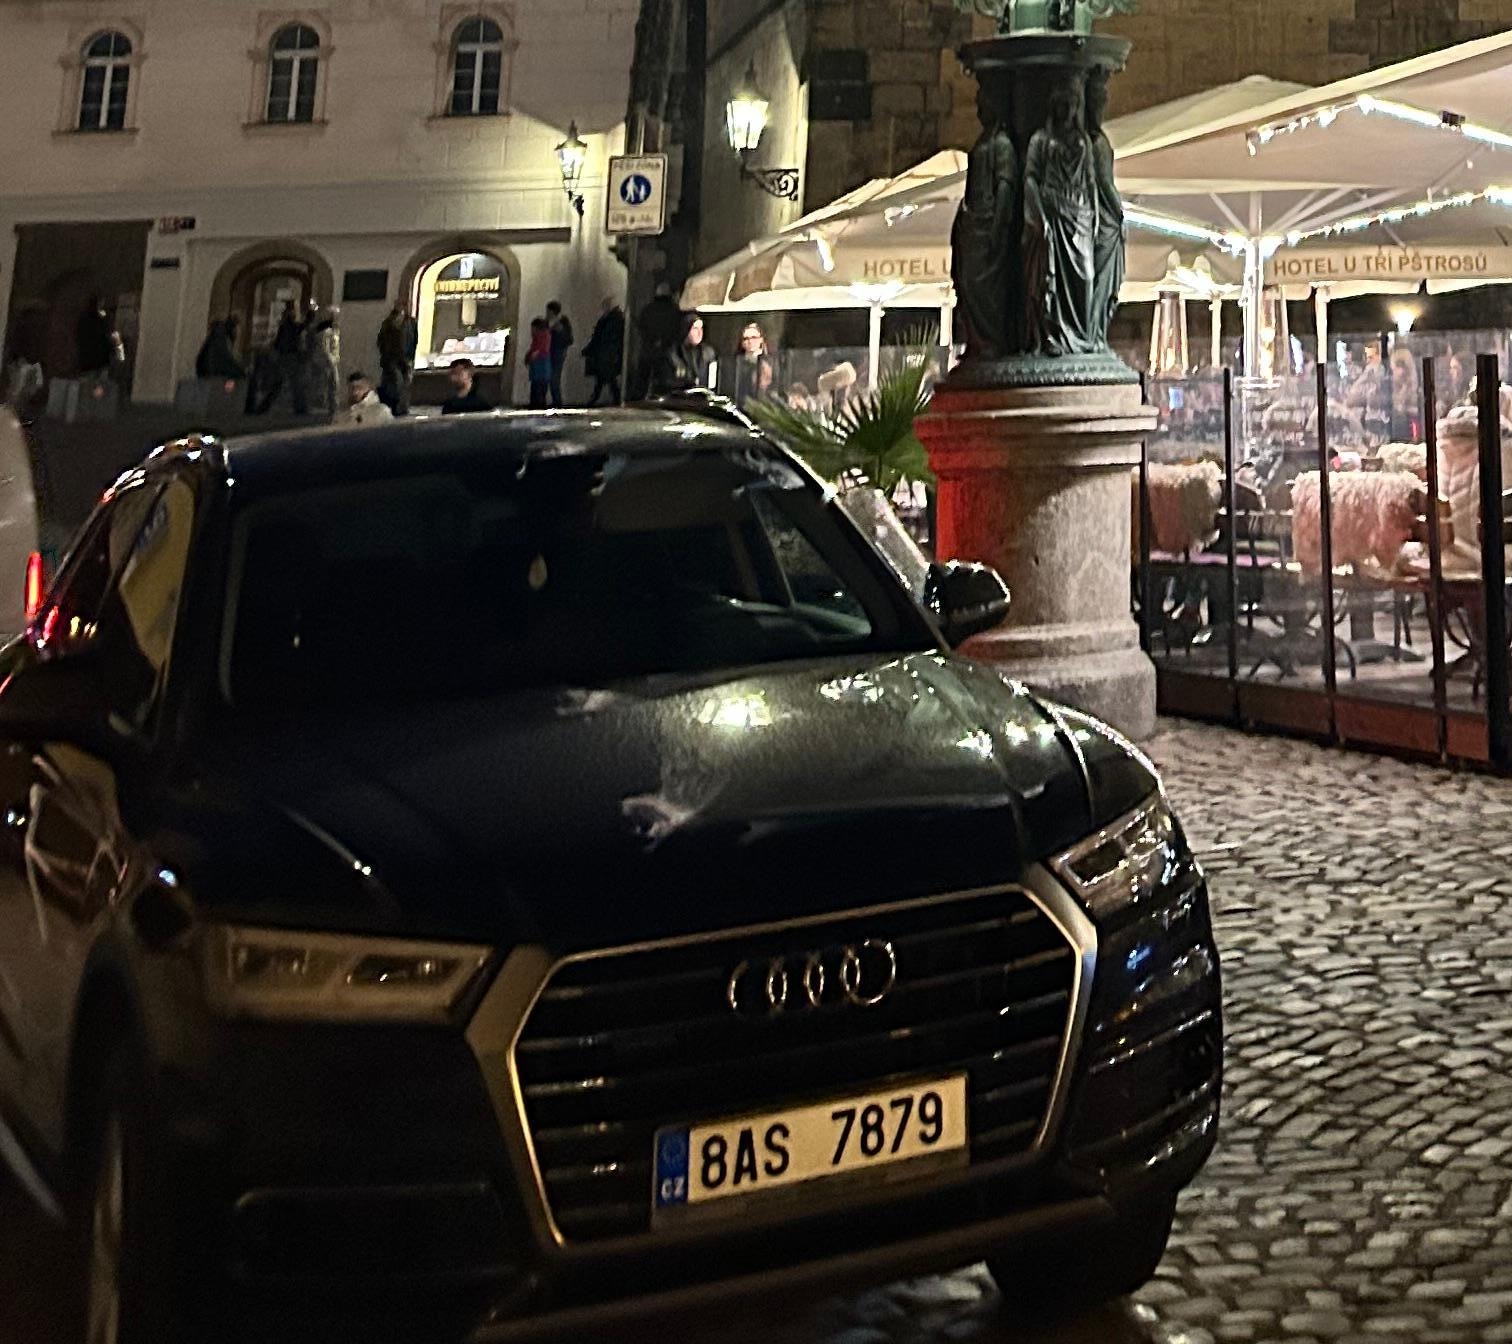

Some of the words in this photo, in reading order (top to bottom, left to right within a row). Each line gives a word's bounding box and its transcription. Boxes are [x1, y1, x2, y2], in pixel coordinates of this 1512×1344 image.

[863, 258, 936, 278] HOTEL
[1273, 257, 1339, 277] HOTEL
[1344, 257, 1357, 273] U
[701, 1122, 790, 1190] 8AS
[831, 1091, 944, 1166] 7879
[660, 1176, 685, 1201] CZ
